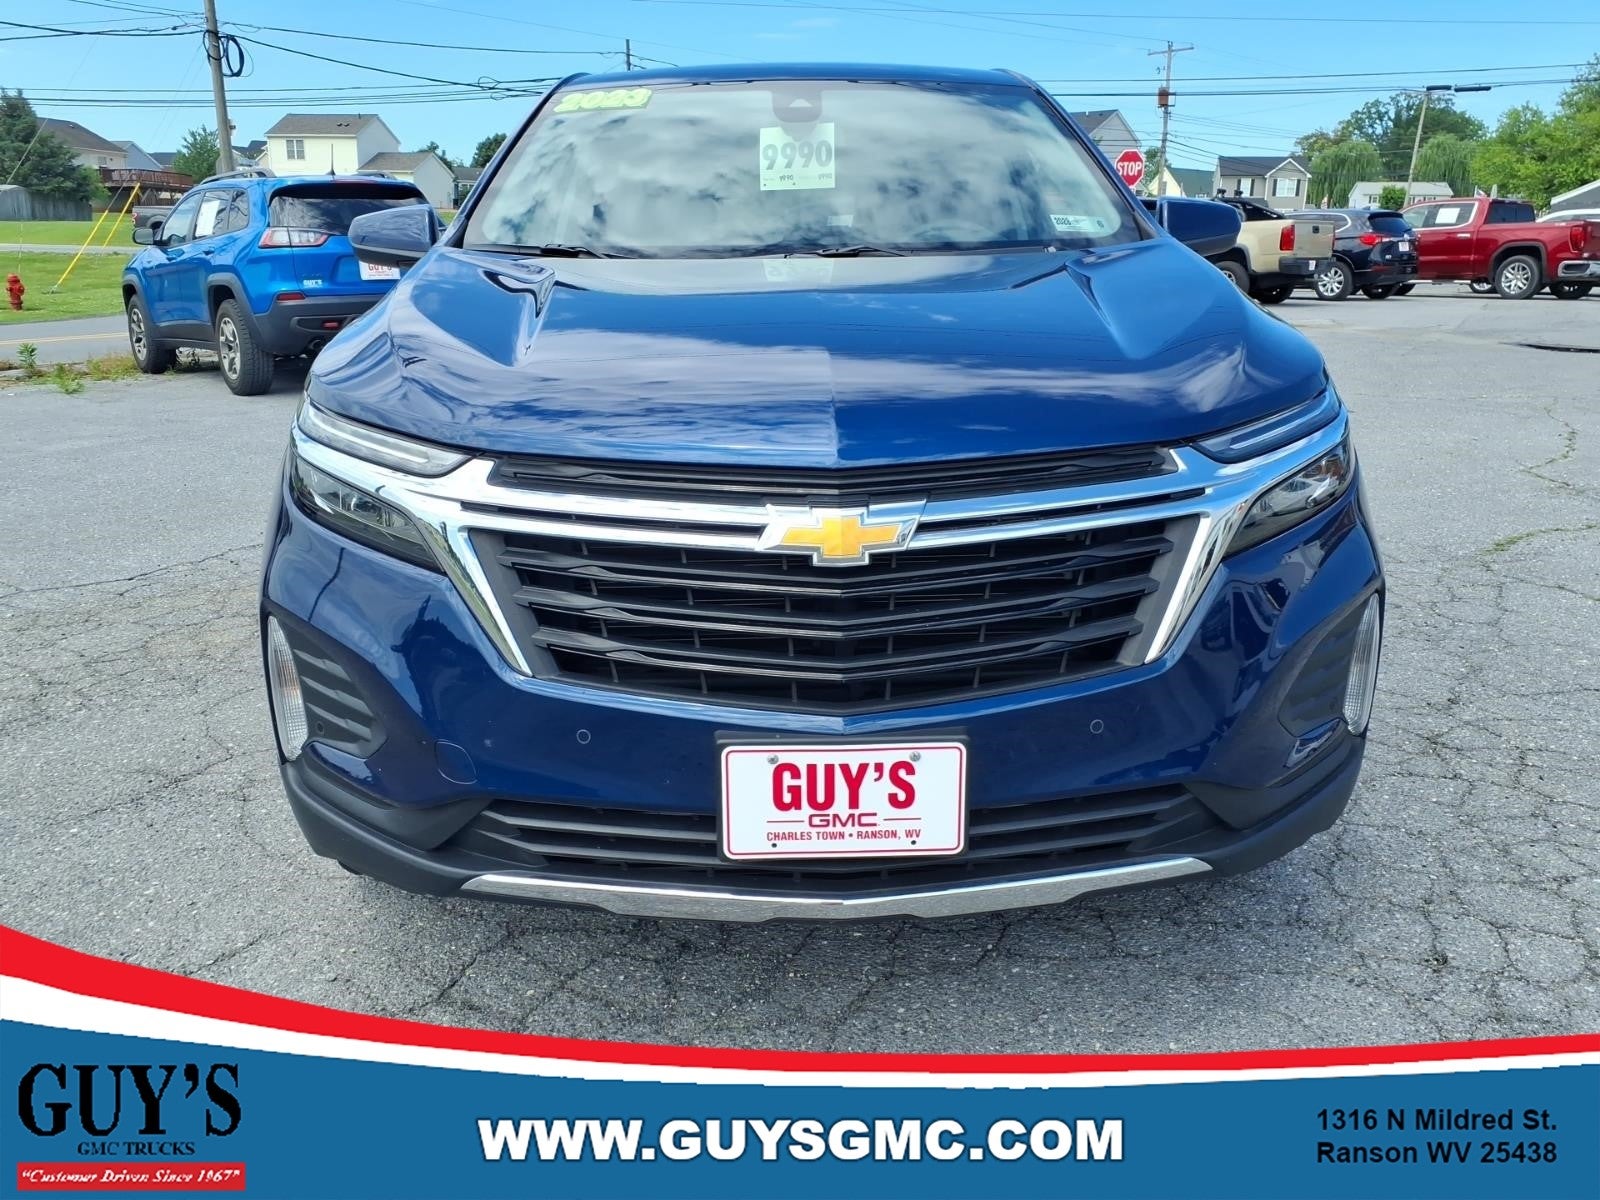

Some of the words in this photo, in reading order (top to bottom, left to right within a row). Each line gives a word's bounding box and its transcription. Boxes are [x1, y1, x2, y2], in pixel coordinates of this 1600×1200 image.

[762, 140, 833, 170] 9990
[1117, 161, 1142, 177] STOP
[772, 760, 916, 812] GUY'S
[808, 812, 877, 828] GMC
[766, 831, 812, 841] CHARLES
[816, 830, 845, 841] TOWN
[857, 830, 901, 841] RANSON,
[905, 829, 921, 839] WV
